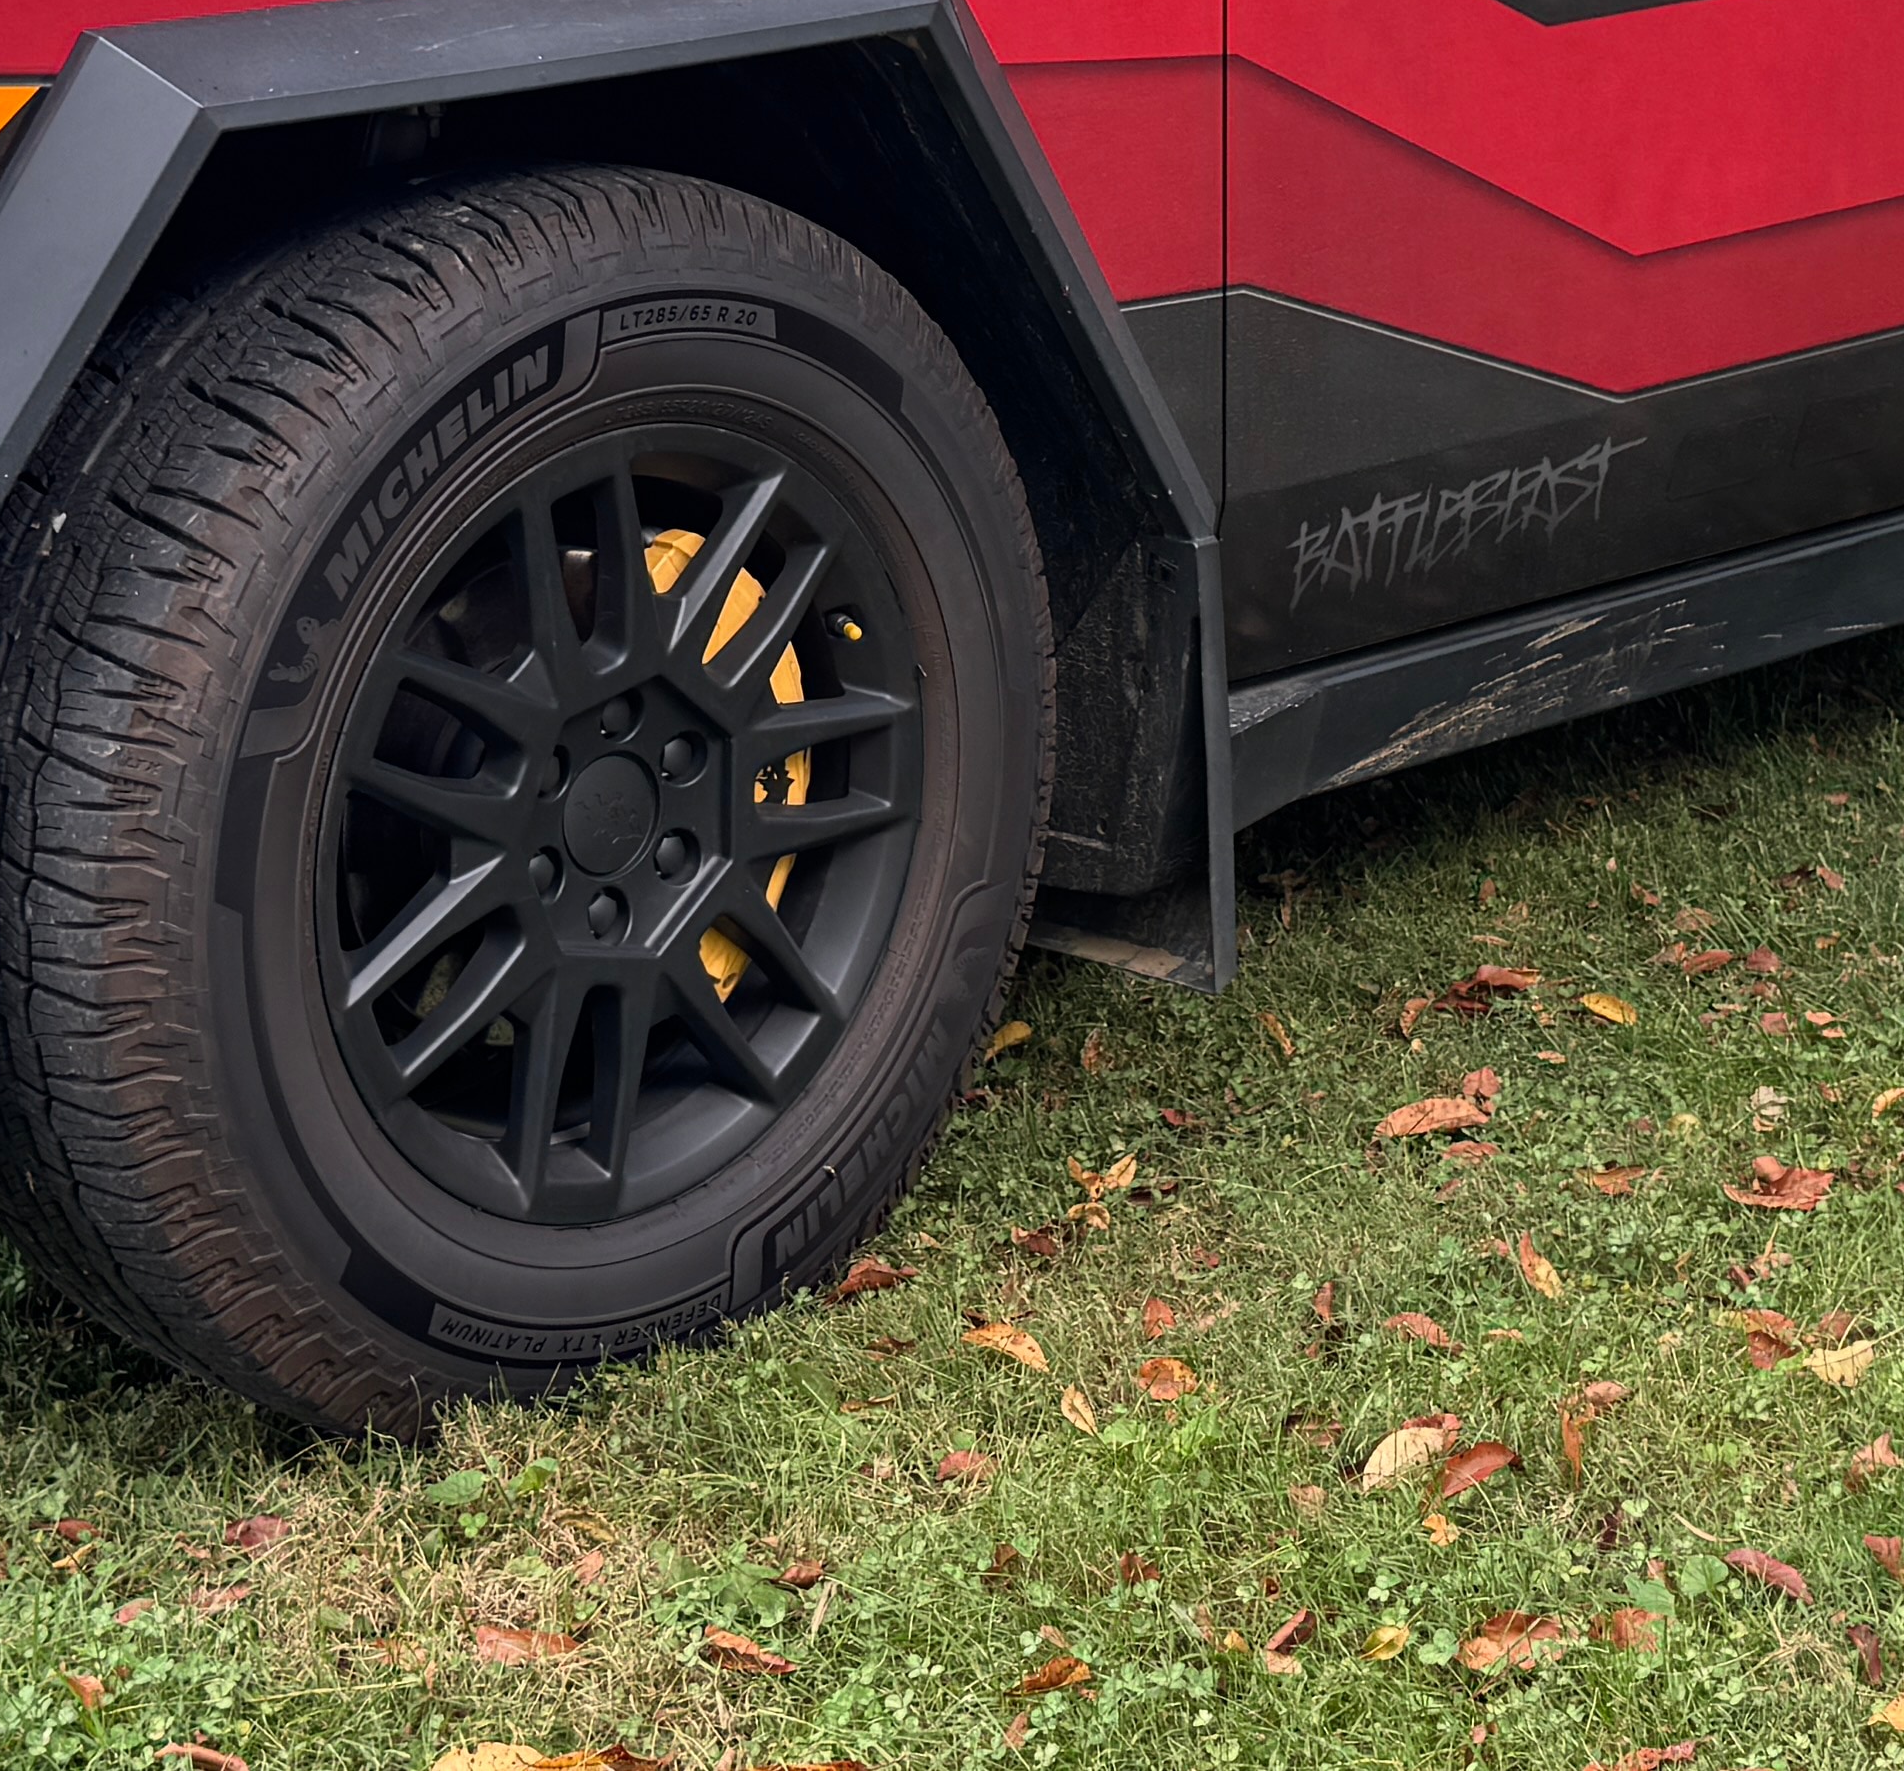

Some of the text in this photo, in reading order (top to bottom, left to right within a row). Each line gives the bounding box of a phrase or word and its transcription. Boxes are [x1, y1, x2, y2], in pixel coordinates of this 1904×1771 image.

[620, 305, 757, 330] LT285/65 R 20
[323, 344, 549, 602] MICHELIN
[1285, 436, 1648, 619] BATTLEBEAST
[775, 1017, 948, 1270] MICHELIN
[441, 1317, 547, 1354] PLATINUM
